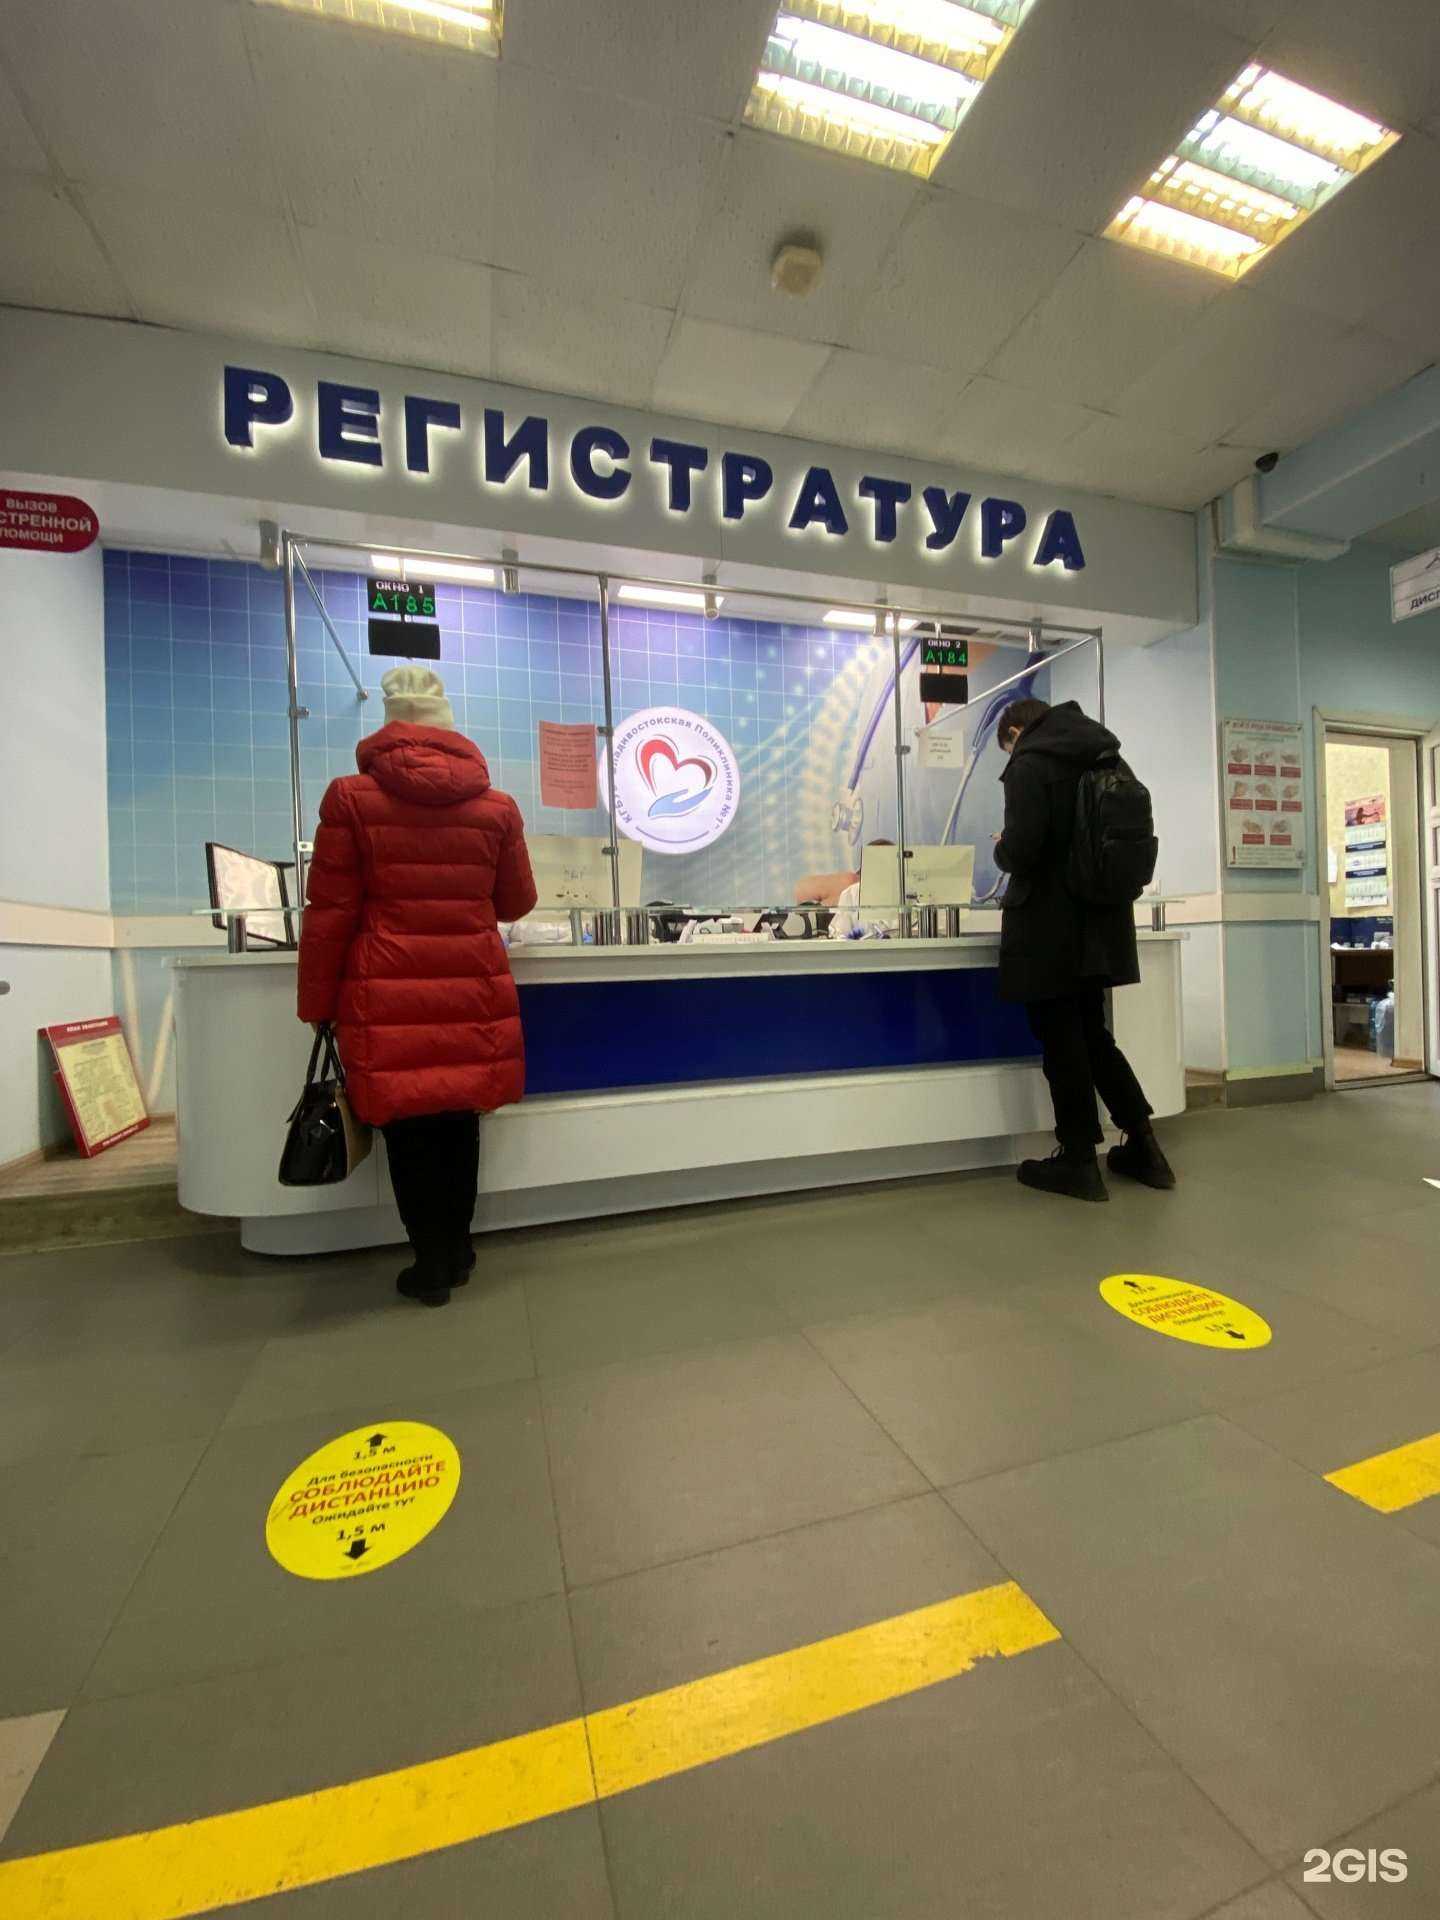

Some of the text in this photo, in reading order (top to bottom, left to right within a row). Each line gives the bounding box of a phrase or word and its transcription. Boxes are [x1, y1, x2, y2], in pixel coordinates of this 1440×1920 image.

[224, 366, 1086, 571] РЕГИСТРАТУРА
[6, 498, 57, 513] ВЫЗОВ
[376, 581, 424, 594] ОКНО 1
[695, 724, 734, 801] Поликлиника
[353, 1447, 377, 1461] 1,5
[290, 1461, 447, 1503] СОБЛЮДАЙТЕ
[307, 1454, 433, 1487] Для безопасности
[288, 1476, 441, 1520] ДИСТАНЦИЮ
[312, 1497, 416, 1525] Ожидайте тут
[336, 1525, 365, 1541] 1,5
